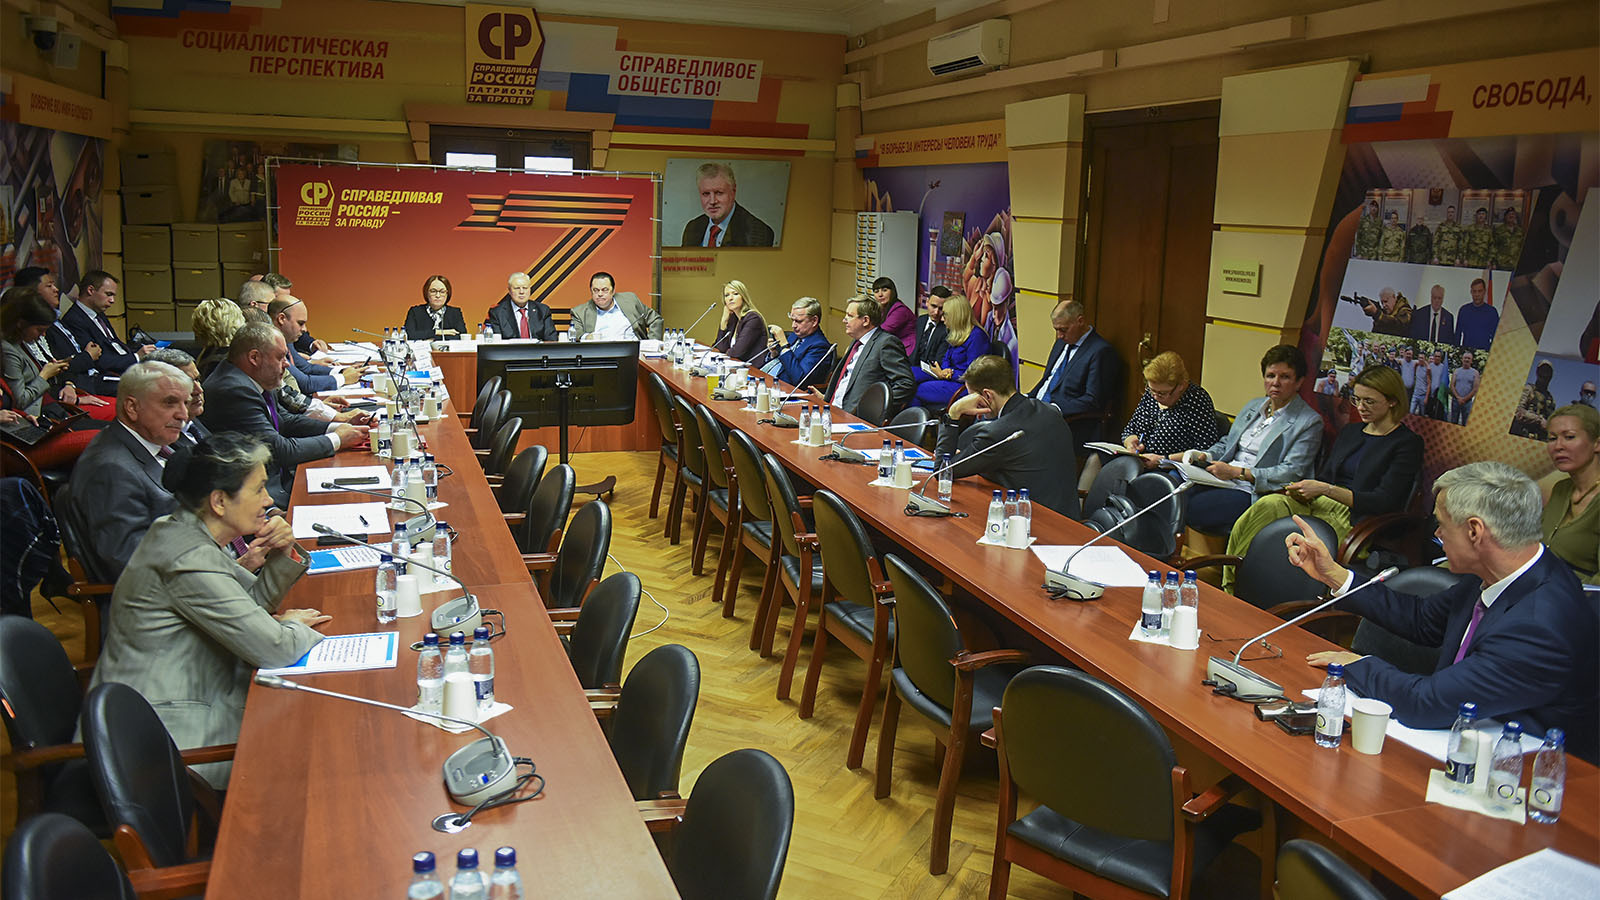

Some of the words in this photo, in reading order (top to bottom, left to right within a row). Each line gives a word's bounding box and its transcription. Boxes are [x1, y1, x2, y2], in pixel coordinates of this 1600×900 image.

[182, 30, 389, 58] СОЦИАЛИСТИЧЕСКАЯ
[478, 12, 532, 60] СР
[249, 56, 385, 80] ПЕРСПЕКТИВА
[474, 64, 538, 75] СПРАВЕДЛИВАЯ
[619, 54, 757, 80] СПРАВЕДЛИВОЕ
[472, 72, 537, 85] РОССИЯ
[617, 74, 721, 97] ОБЩЕСТВО!
[468, 86, 536, 96] ПАТРИОТЫ
[1472, 75, 1592, 111] СВОБОДА,
[487, 95, 532, 105] ПРАВДУ
[944, 135, 976, 150] ЧЕЛОВЕКА
[300, 181, 329, 205] СР
[341, 188, 444, 205] СПРАВЕДЛИВАЯ
[337, 203, 390, 218] РОССИЯ
[335, 218, 347, 227] ЗА
[348, 218, 386, 230] ПРАВДУ
